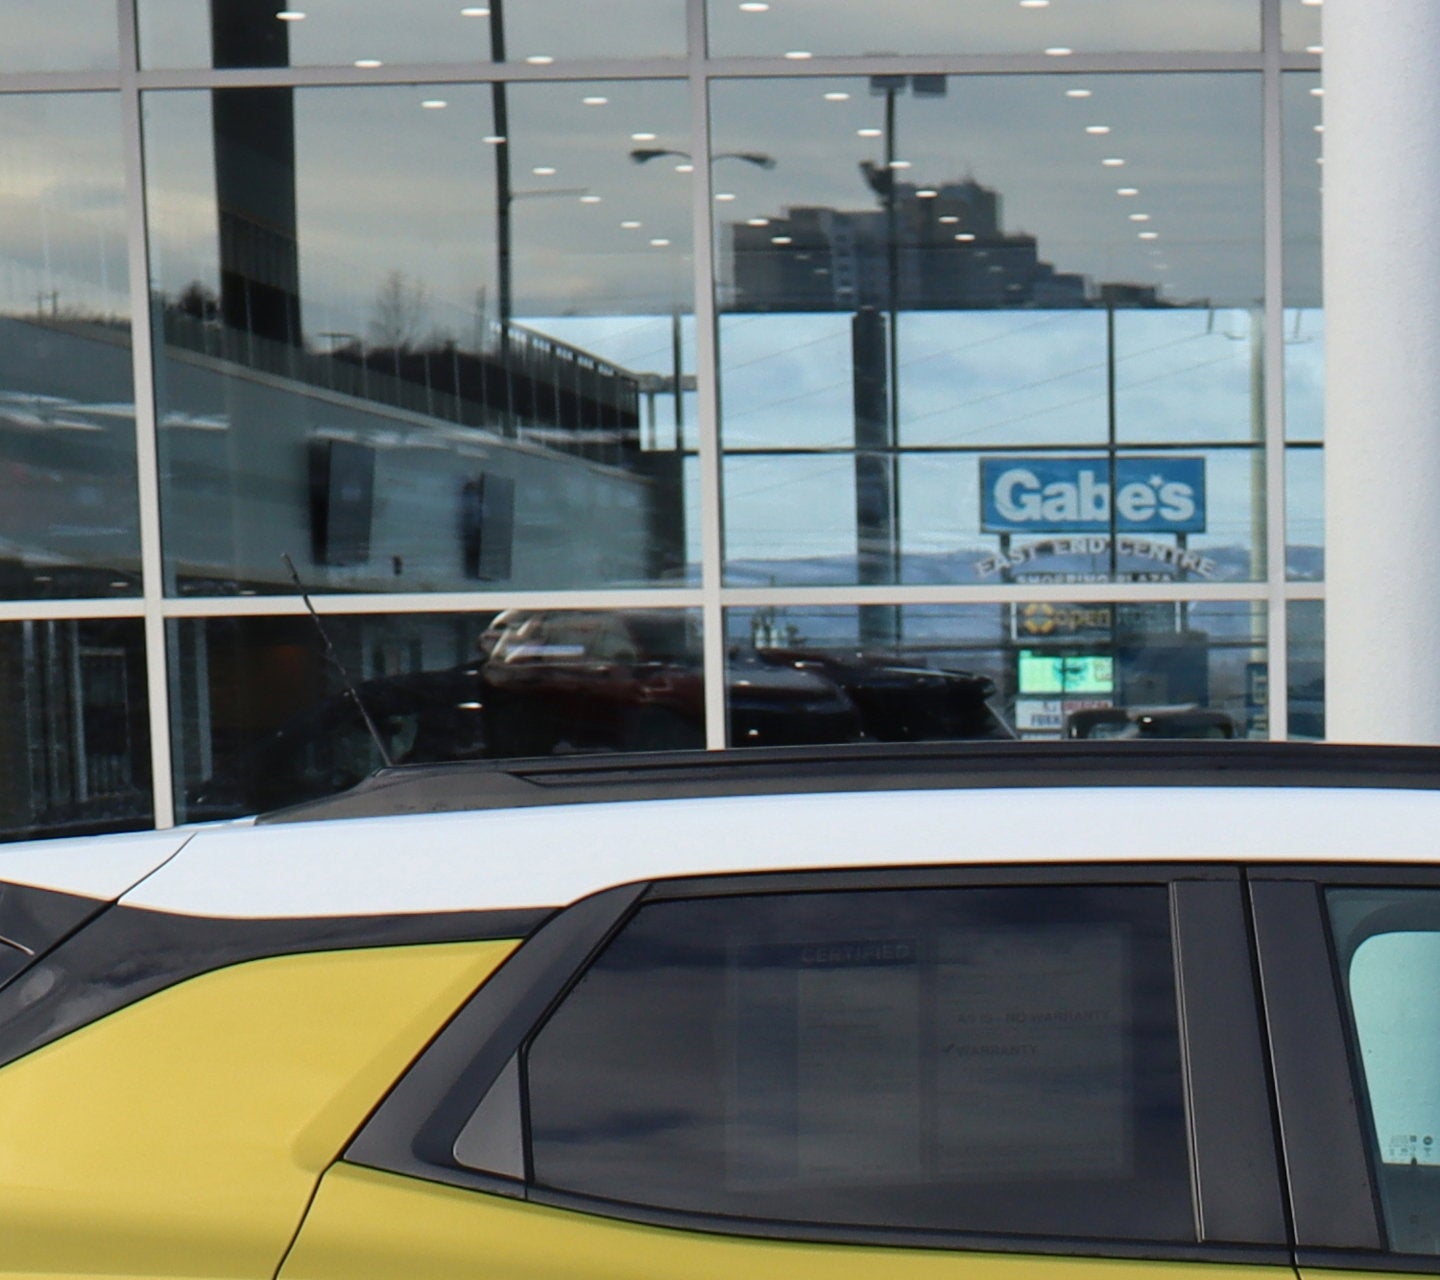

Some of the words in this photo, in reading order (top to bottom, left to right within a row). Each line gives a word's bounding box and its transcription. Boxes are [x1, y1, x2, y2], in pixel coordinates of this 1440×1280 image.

[993, 468, 1196, 523] Gabe's
[975, 541, 1040, 579] EAST
[1052, 538, 1109, 556] END
[1117, 537, 1216, 579] CENTRE
[801, 944, 910, 963] CERTIFIED
